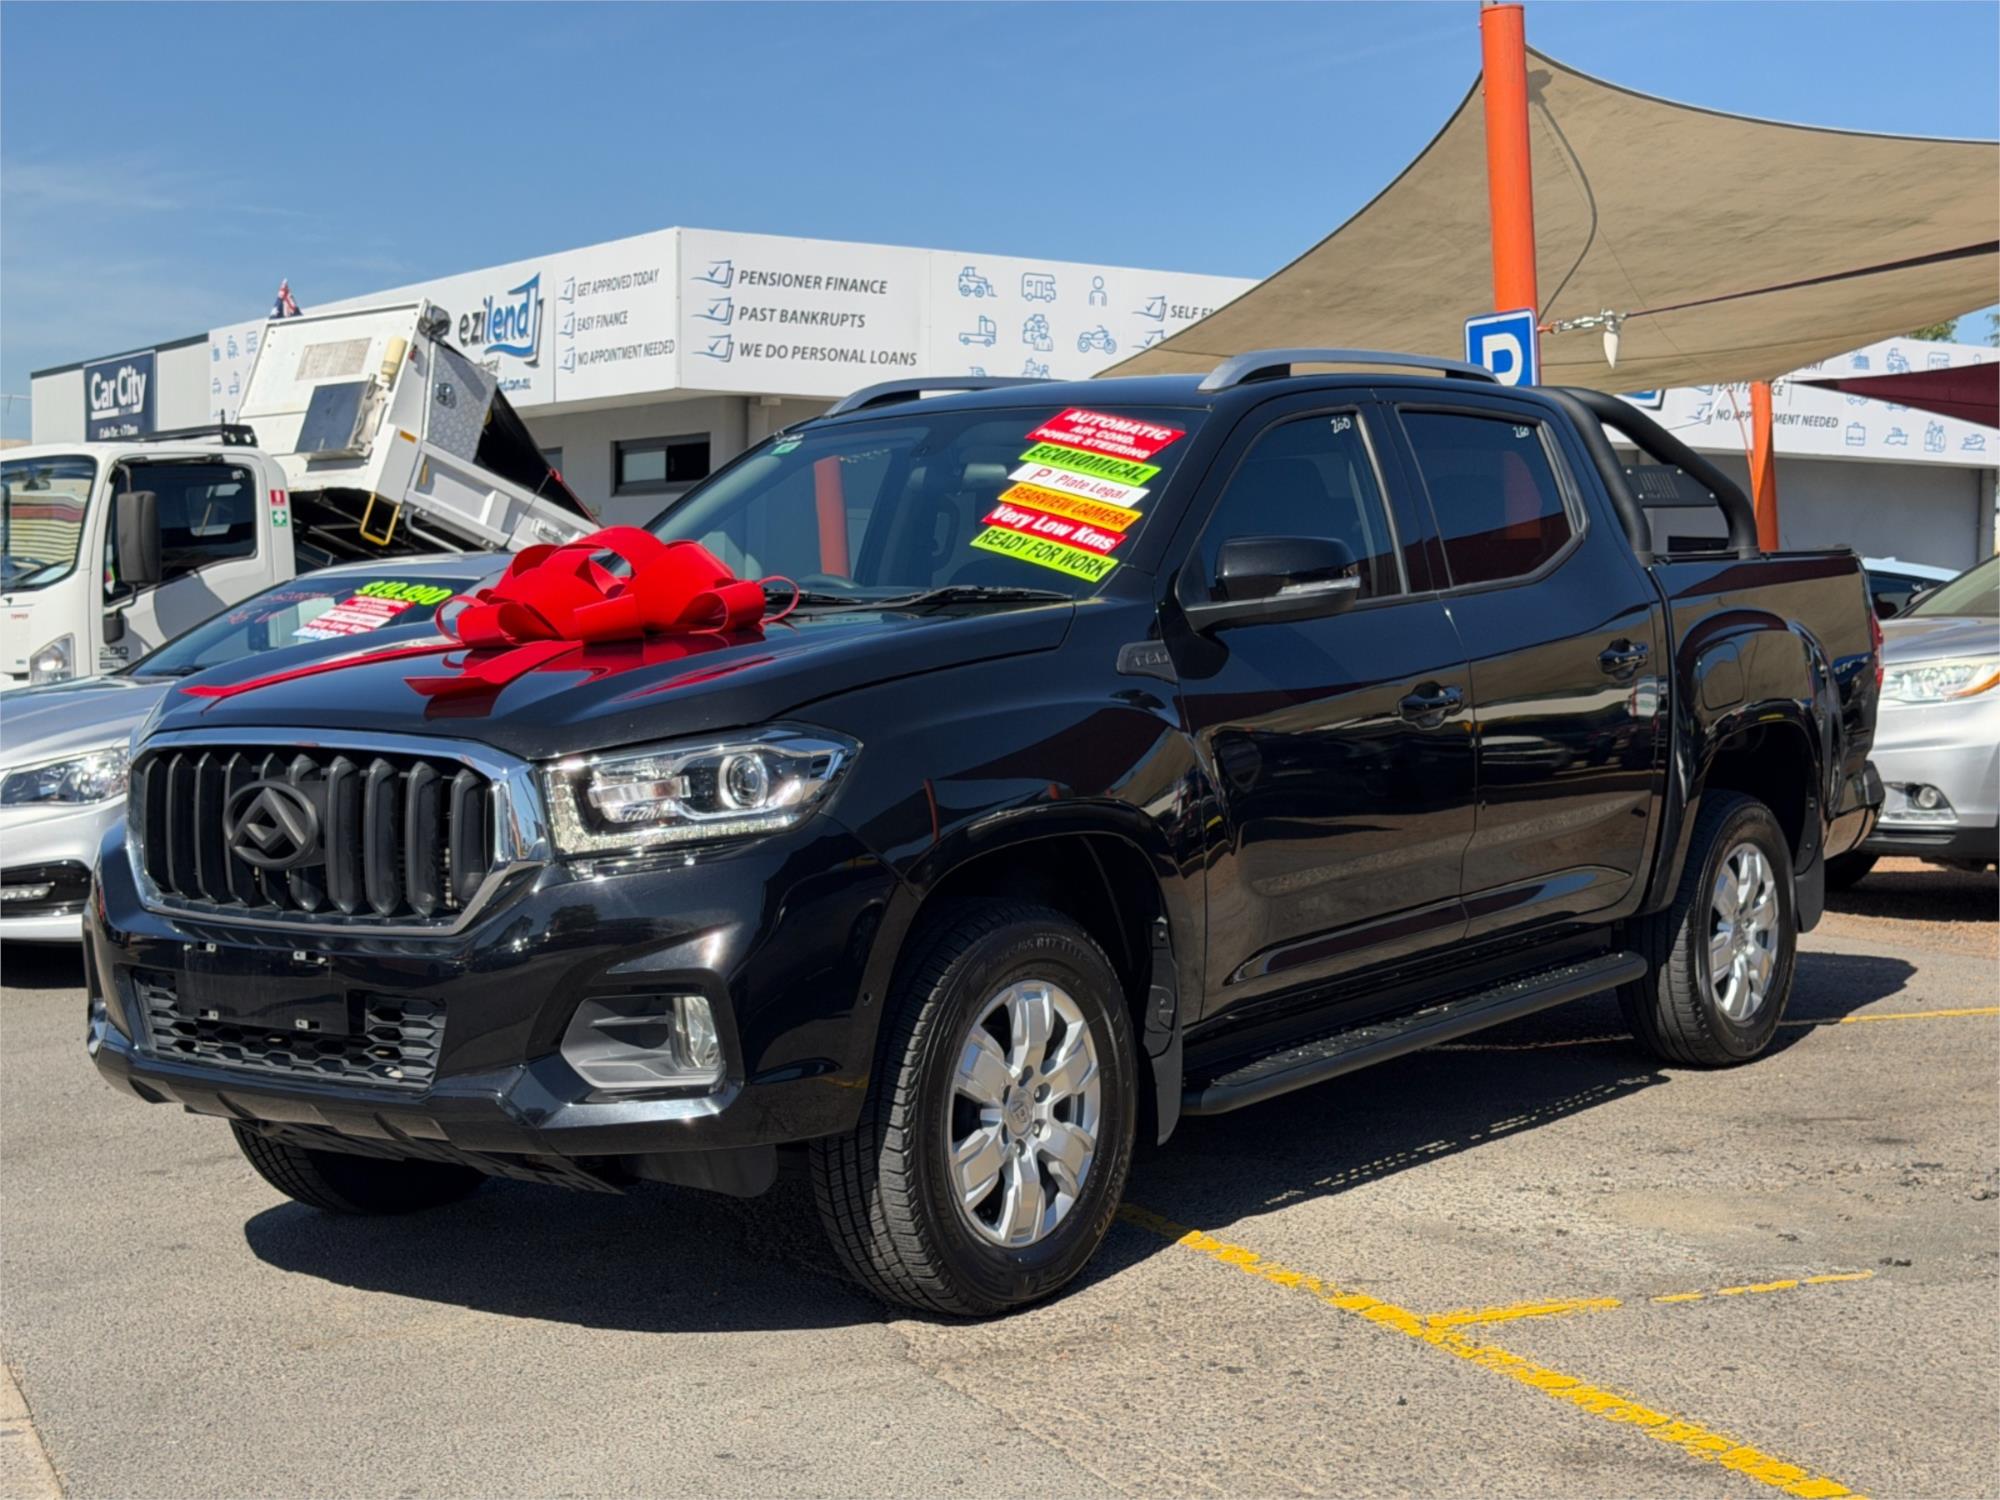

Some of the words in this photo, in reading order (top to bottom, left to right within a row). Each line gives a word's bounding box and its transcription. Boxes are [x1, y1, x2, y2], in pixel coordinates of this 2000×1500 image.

[578, 281, 591, 297] GET
[592, 274, 632, 294] APPROVED
[633, 268, 660, 287] TODAY
[739, 270, 822, 290] PENSIONER
[825, 276, 888, 294] FINANCE
[577, 316, 595, 332] EASY
[596, 310, 629, 329] FINANCE
[739, 306, 777, 322] PAST
[779, 309, 866, 328] BANKRUPTS
[1170, 305, 1199, 319] SELF
[577, 352, 589, 366] NO
[590, 344, 643, 364] APPOINTMENT
[644, 339, 676, 357] NEEDED
[739, 342, 763, 358] WE
[765, 344, 788, 359] DO
[791, 346, 867, 364] PERSONAL
[869, 351, 917, 366] LOANS
[1482, 333, 1523, 386] P
[91, 372, 116, 411] Car
[118, 365, 146, 414] City
[1064, 411, 1173, 440] AUTOMATIC
[1070, 425, 1097, 437] AIR
[1716, 409, 1731, 421] NO
[1801, 415, 1839, 428] NEEDED
[1035, 428, 1084, 443] POWER
[1082, 438, 1151, 458] STEERING
[1030, 446, 1150, 480] ECONOMICAL
[1029, 468, 1051, 481] P
[1054, 475, 1090, 489] Plate
[1090, 481, 1130, 499] Legal
[1011, 487, 1072, 510] REARVIEW
[1071, 500, 1134, 527] CAMERA
[991, 505, 1034, 528] Very
[1032, 515, 1073, 536] Low
[1070, 527, 1116, 550] Kms
[979, 530, 1029, 551] READY
[1027, 542, 1060, 562] FOR
[1058, 553, 1110, 577] WORK
